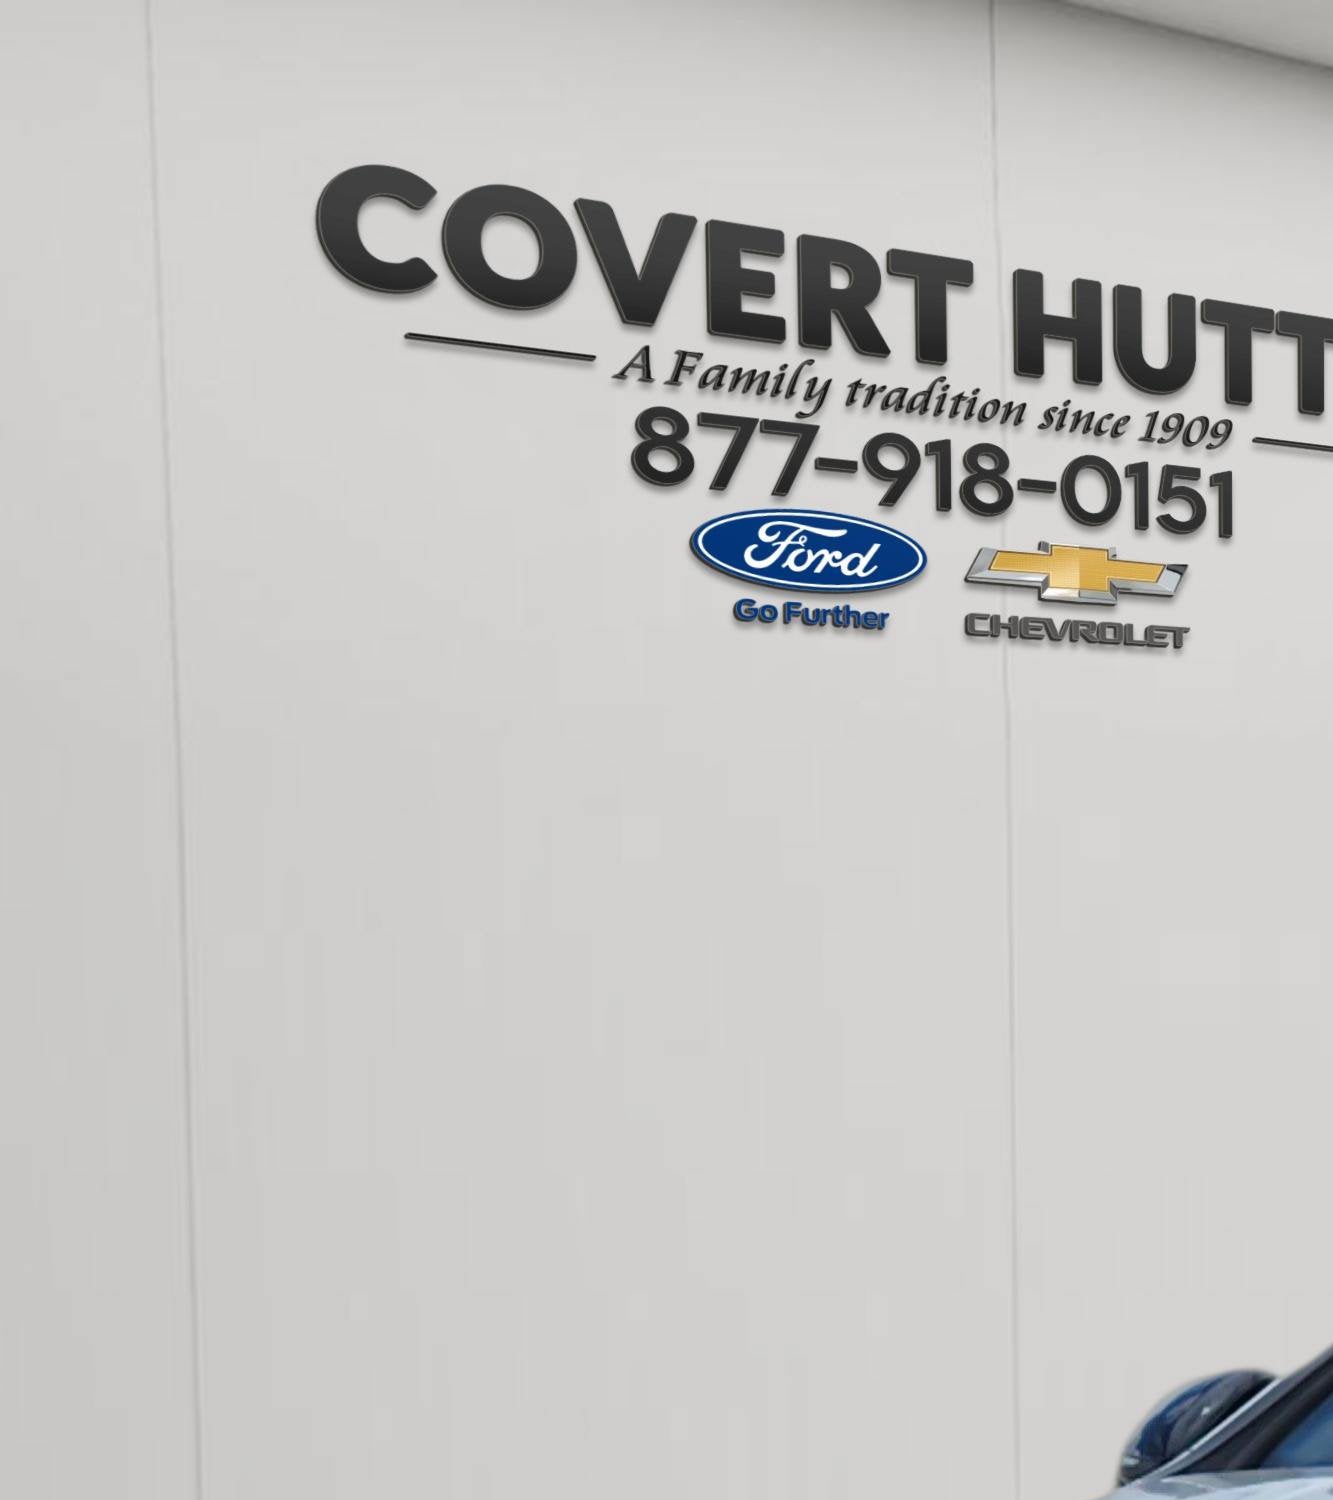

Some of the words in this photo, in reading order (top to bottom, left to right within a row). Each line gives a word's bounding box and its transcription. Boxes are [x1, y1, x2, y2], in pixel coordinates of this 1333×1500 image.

[315, 163, 974, 365] COVERT
[611, 344, 655, 384] A
[664, 349, 834, 419] Family
[845, 375, 1028, 429] tradition
[1037, 397, 1131, 438] since
[1143, 409, 1234, 451] 1909
[629, 405, 1234, 539] 877-918-0151
[743, 519, 882, 580] Ford
[732, 597, 779, 624] Go
[783, 600, 890, 631] Further
[963, 612, 1191, 649] CHEVROLET
